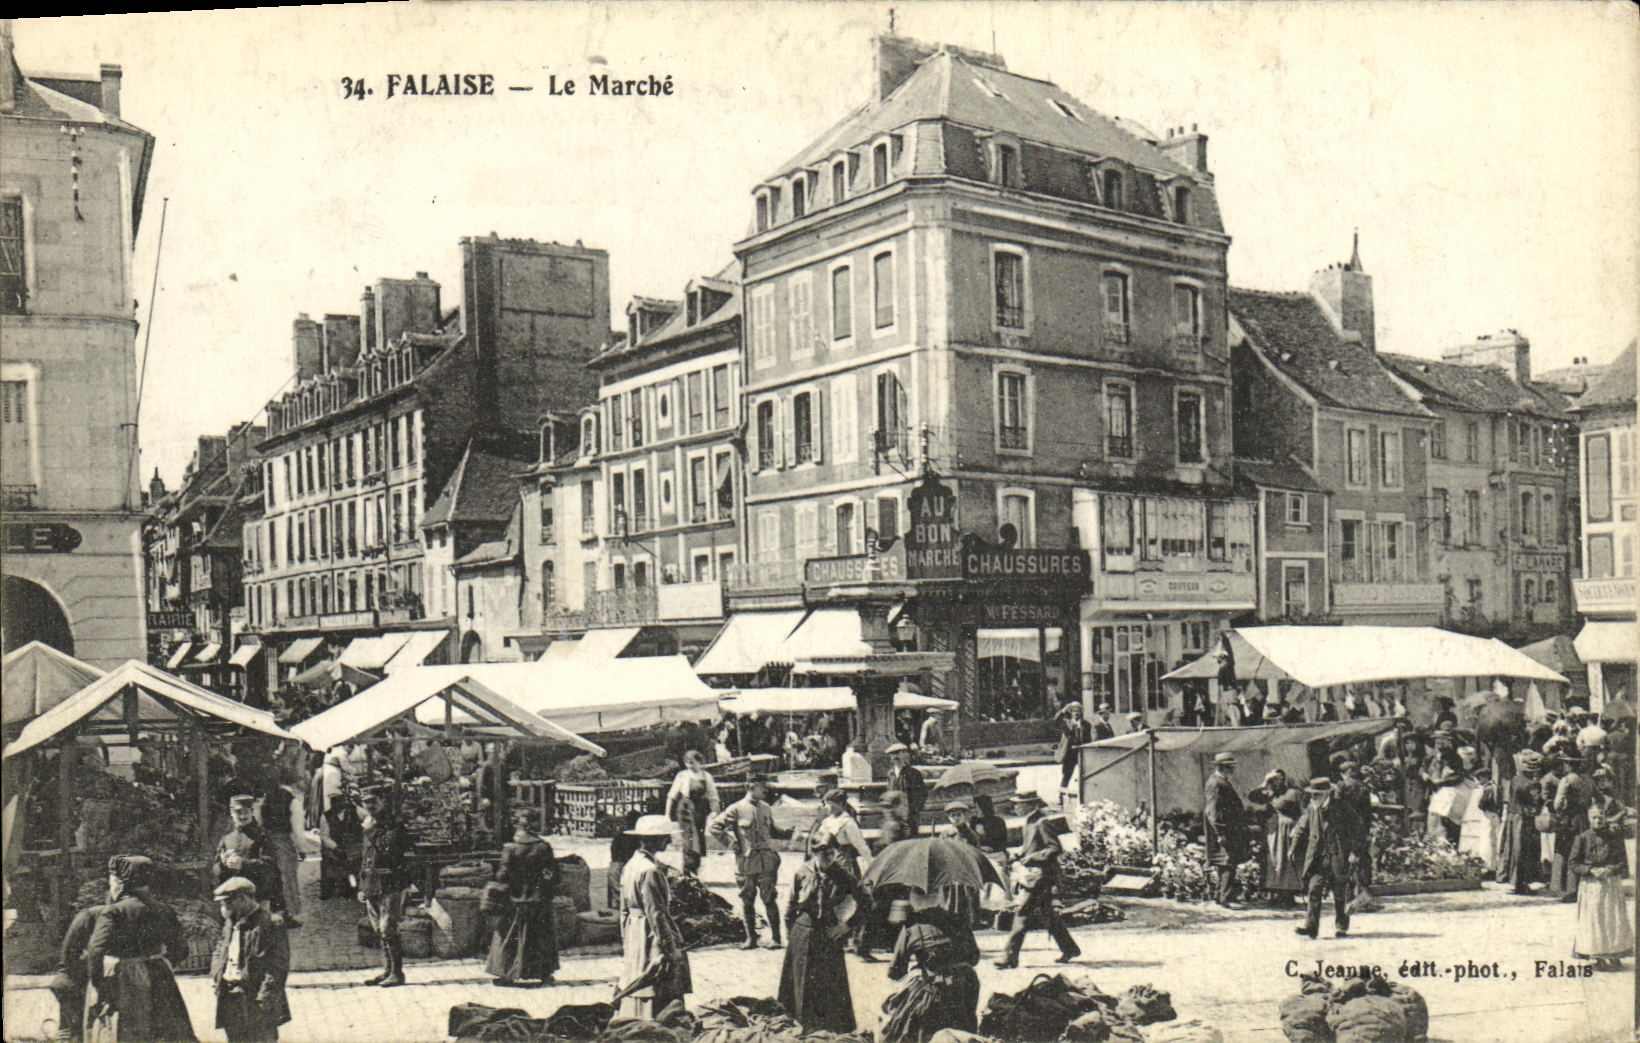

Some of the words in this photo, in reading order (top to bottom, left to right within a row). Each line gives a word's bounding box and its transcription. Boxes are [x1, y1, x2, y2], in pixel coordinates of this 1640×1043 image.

[921, 497, 945, 517] AU
[915, 523, 951, 543] BON
[812, 554, 899, 583] CHAUSSES
[967, 553, 1082, 574] CHAUSSURES
